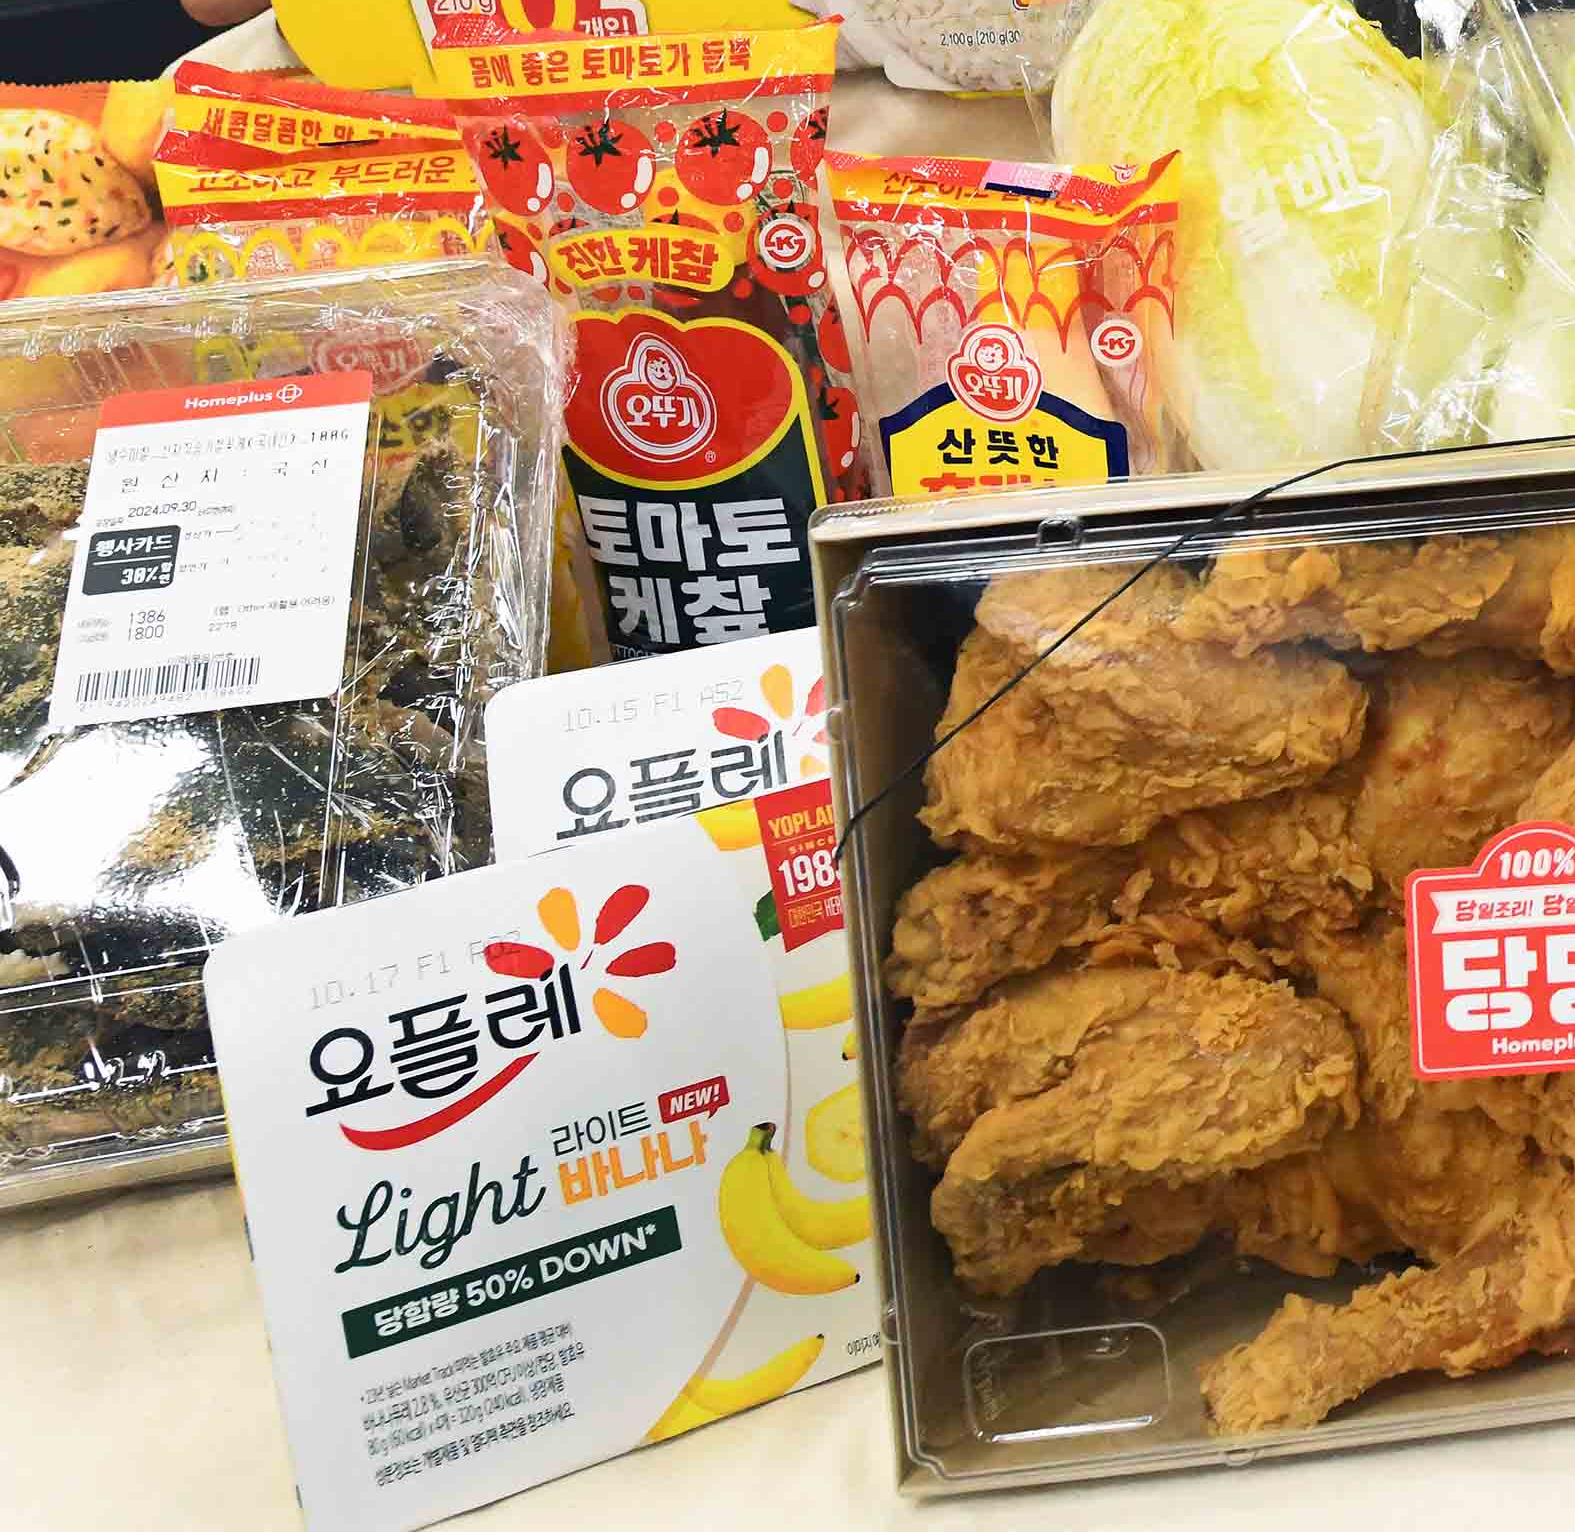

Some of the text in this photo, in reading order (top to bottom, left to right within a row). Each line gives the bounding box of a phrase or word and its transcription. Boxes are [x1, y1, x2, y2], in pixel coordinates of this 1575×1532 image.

[469, 36, 752, 89] 몸에 좋은 토마토가 듬뿍
[201, 107, 323, 148] 새콤달콤한
[328, 155, 456, 187] 부드러운
[556, 235, 720, 286] 진한 케찹
[184, 388, 274, 411] Homeplus
[964, 374, 1024, 404] 오뚜기
[625, 393, 701, 429] 오뚜기
[936, 428, 1060, 470] 산뜻한
[127, 501, 197, 518] 2024.09.30
[95, 534, 174, 557] 행사카드
[577, 494, 800, 570] 토마토
[120, 568, 159, 586] 30%
[129, 609, 166, 626] 1386
[607, 574, 772, 645] 케찹
[128, 624, 165, 642] 1800
[556, 730, 788, 841] 요플레
[1455, 899, 1534, 923] 당일조리!
[309, 961, 400, 1011] 10.17
[417, 948, 450, 978] F1
[304, 959, 583, 1119] 요플레
[668, 1082, 722, 1119] NEW!
[552, 1101, 653, 1158] 라이트
[559, 1118, 714, 1207] 바나나
[333, 1154, 547, 1274] Light
[373, 1289, 460, 1337] 당함량
[466, 1261, 536, 1307] 50%
